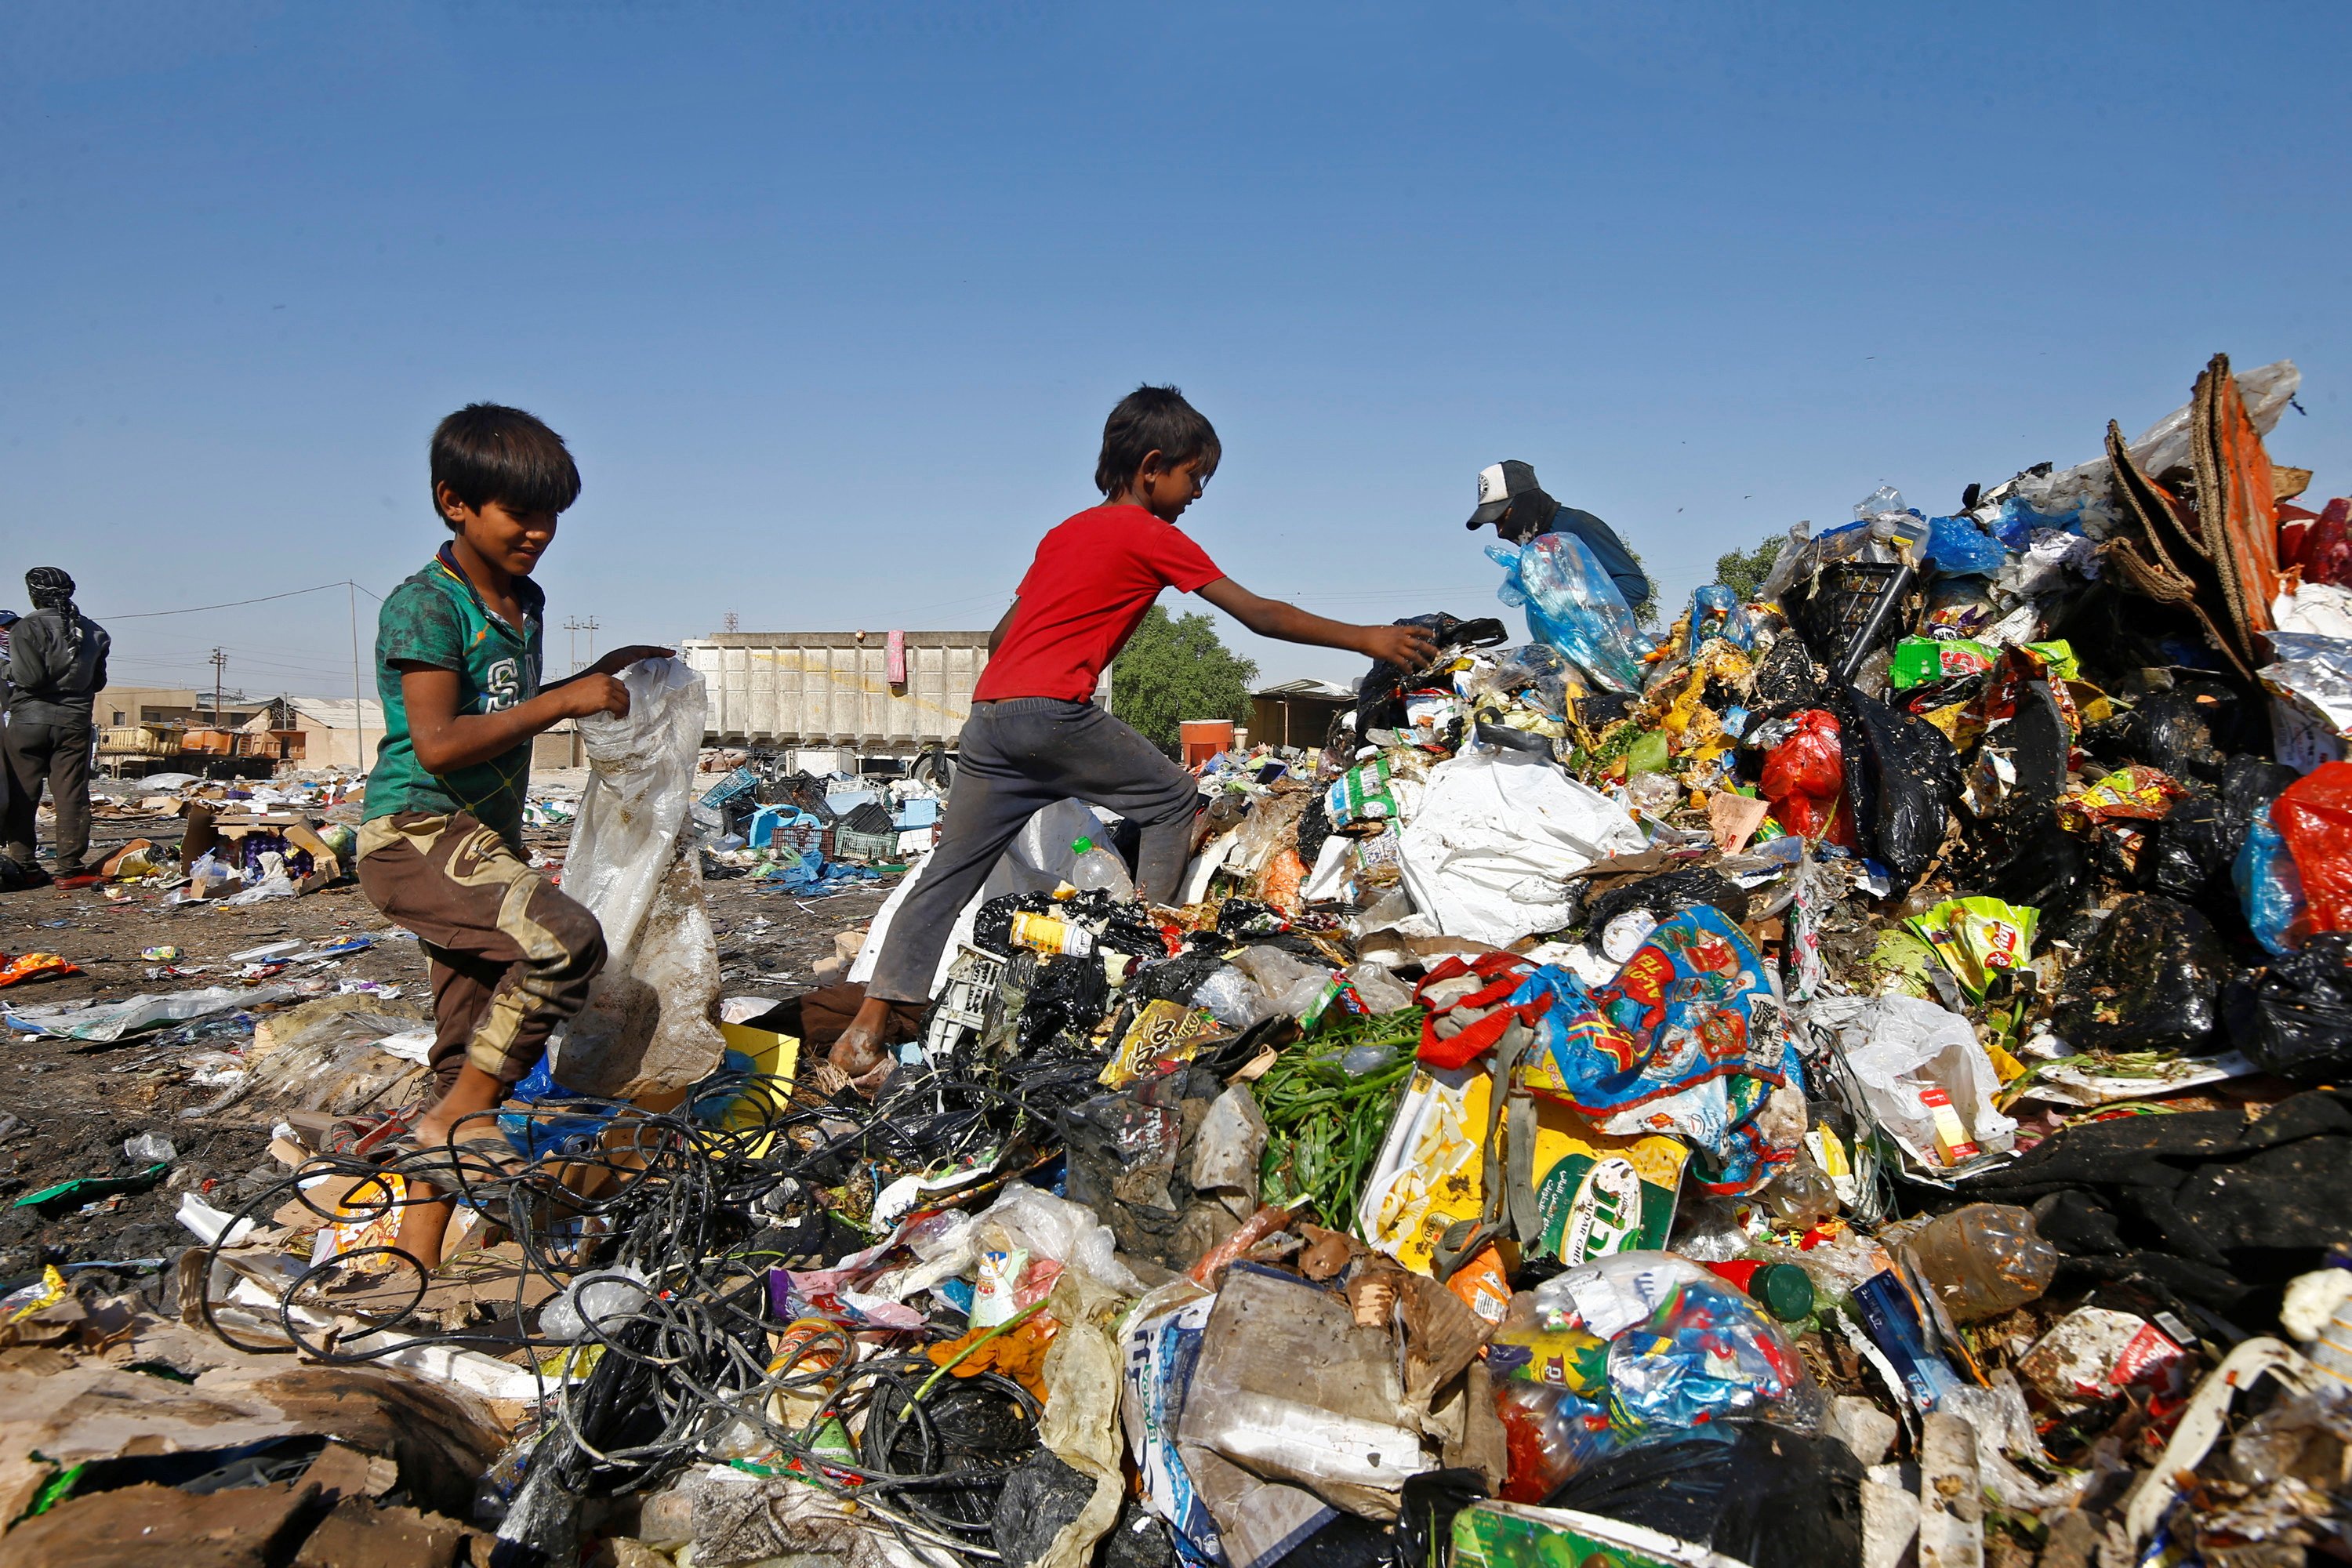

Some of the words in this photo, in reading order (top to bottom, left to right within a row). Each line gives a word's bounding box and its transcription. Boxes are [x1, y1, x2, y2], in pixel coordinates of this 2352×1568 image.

[1635, 953, 1663, 975] TEA
[1580, 1199, 1595, 1236] ALDAR
[1907, 1373, 1933, 1408] Crest
